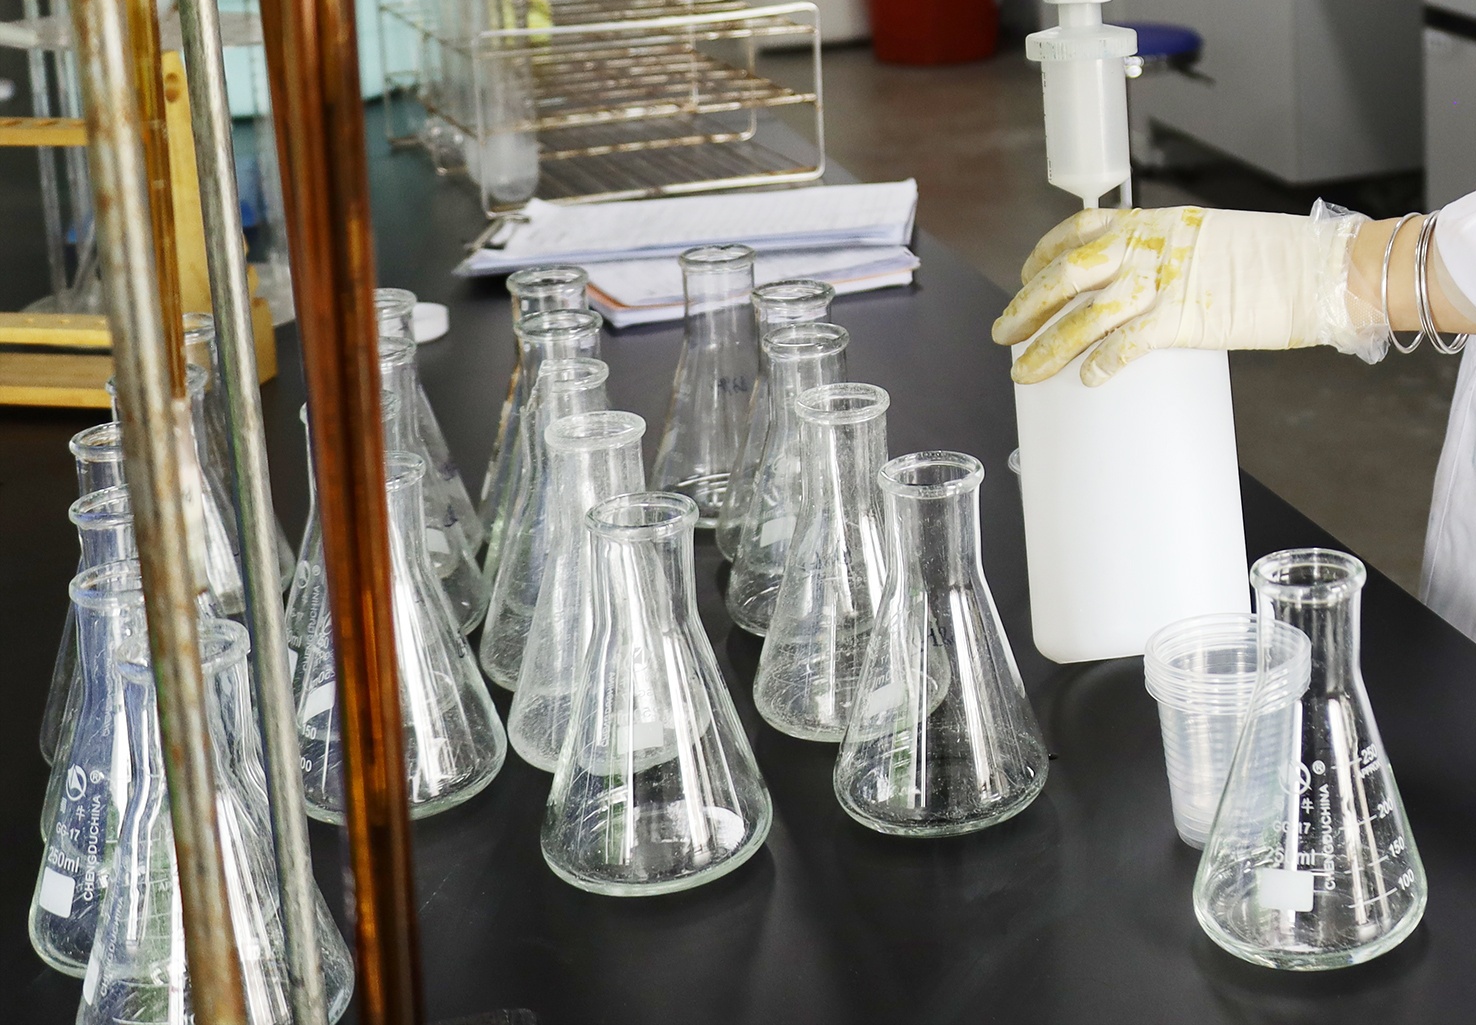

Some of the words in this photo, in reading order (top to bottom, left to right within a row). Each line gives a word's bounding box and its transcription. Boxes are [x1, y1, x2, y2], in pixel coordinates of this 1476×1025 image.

[1361, 743, 1378, 765] 250
[1377, 797, 1394, 820] 200
[1389, 835, 1405, 858] 150
[48, 845, 80, 874] 250ml
[1397, 868, 1416, 891] 100
